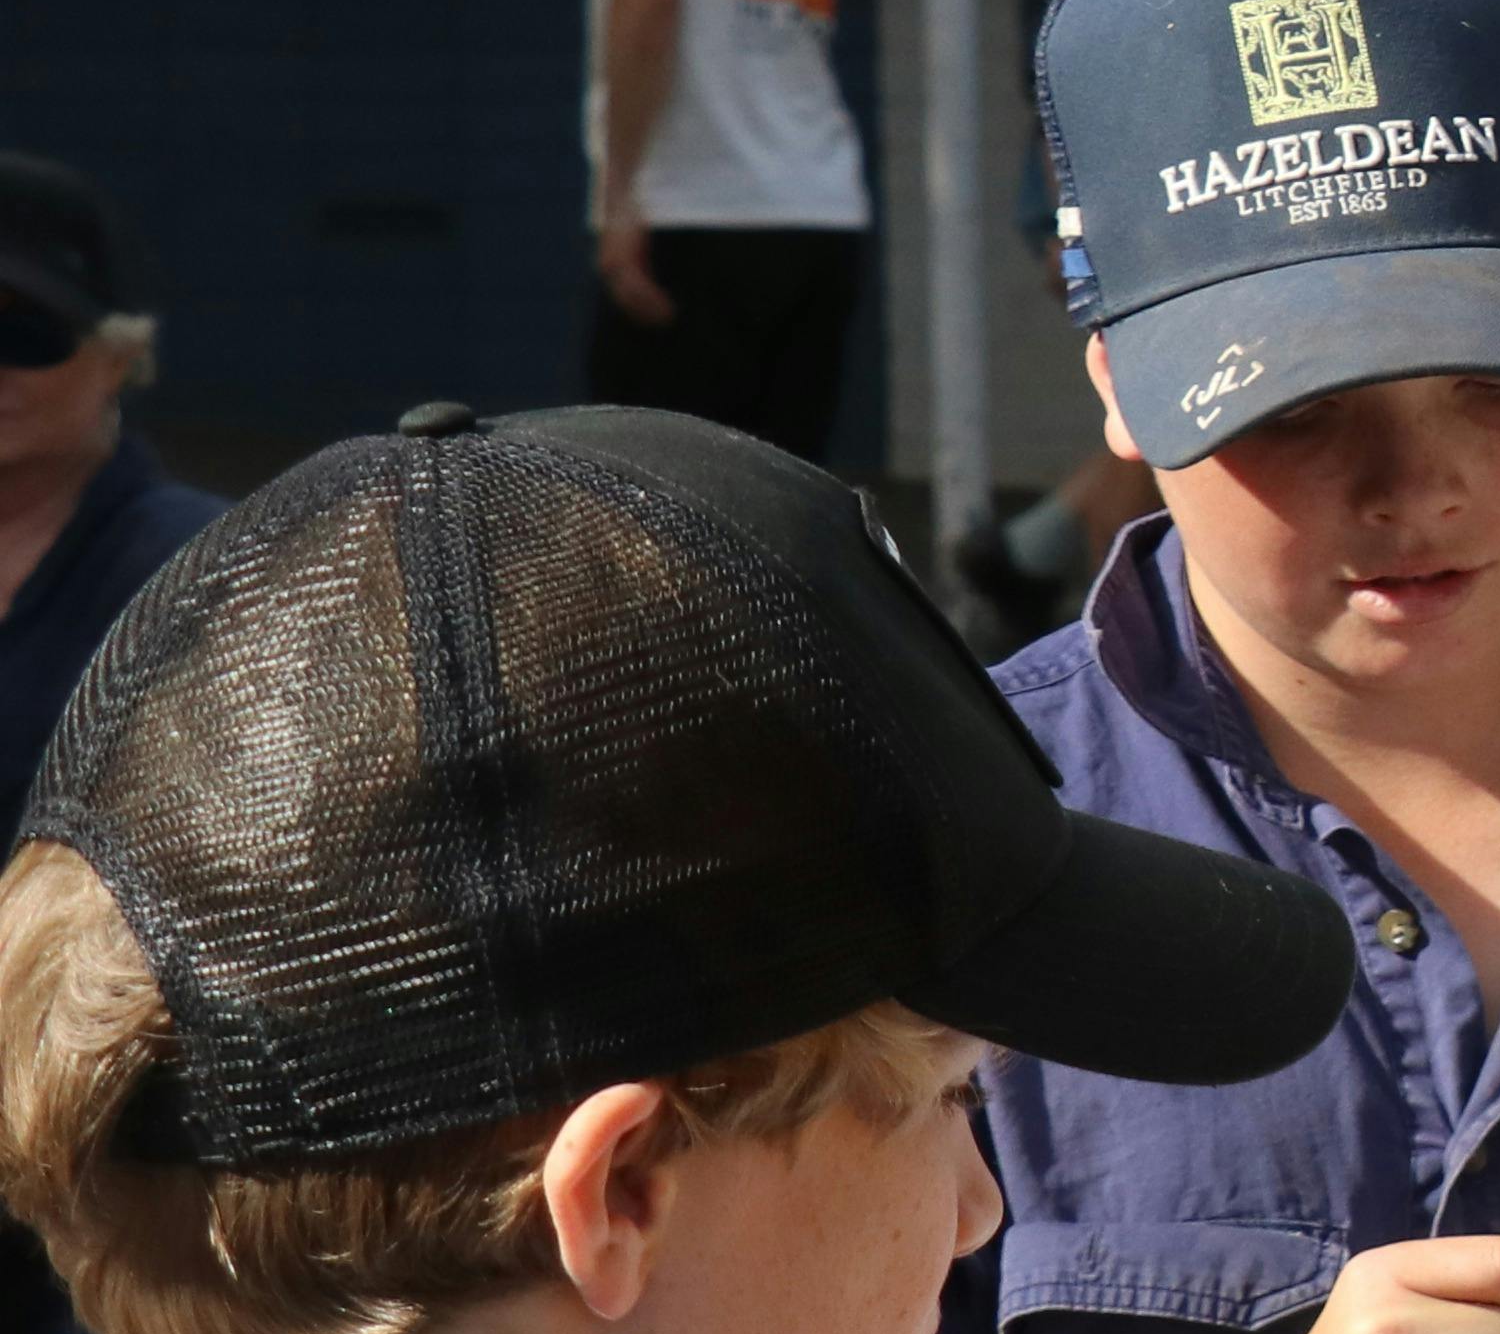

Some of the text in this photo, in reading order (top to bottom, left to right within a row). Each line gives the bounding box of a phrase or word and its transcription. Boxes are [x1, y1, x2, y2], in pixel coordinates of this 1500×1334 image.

[1159, 115, 1499, 214] HAZELDEAN
[1236, 167, 1429, 217] LITCHFIELD
[1287, 191, 1388, 225] EST 1865
